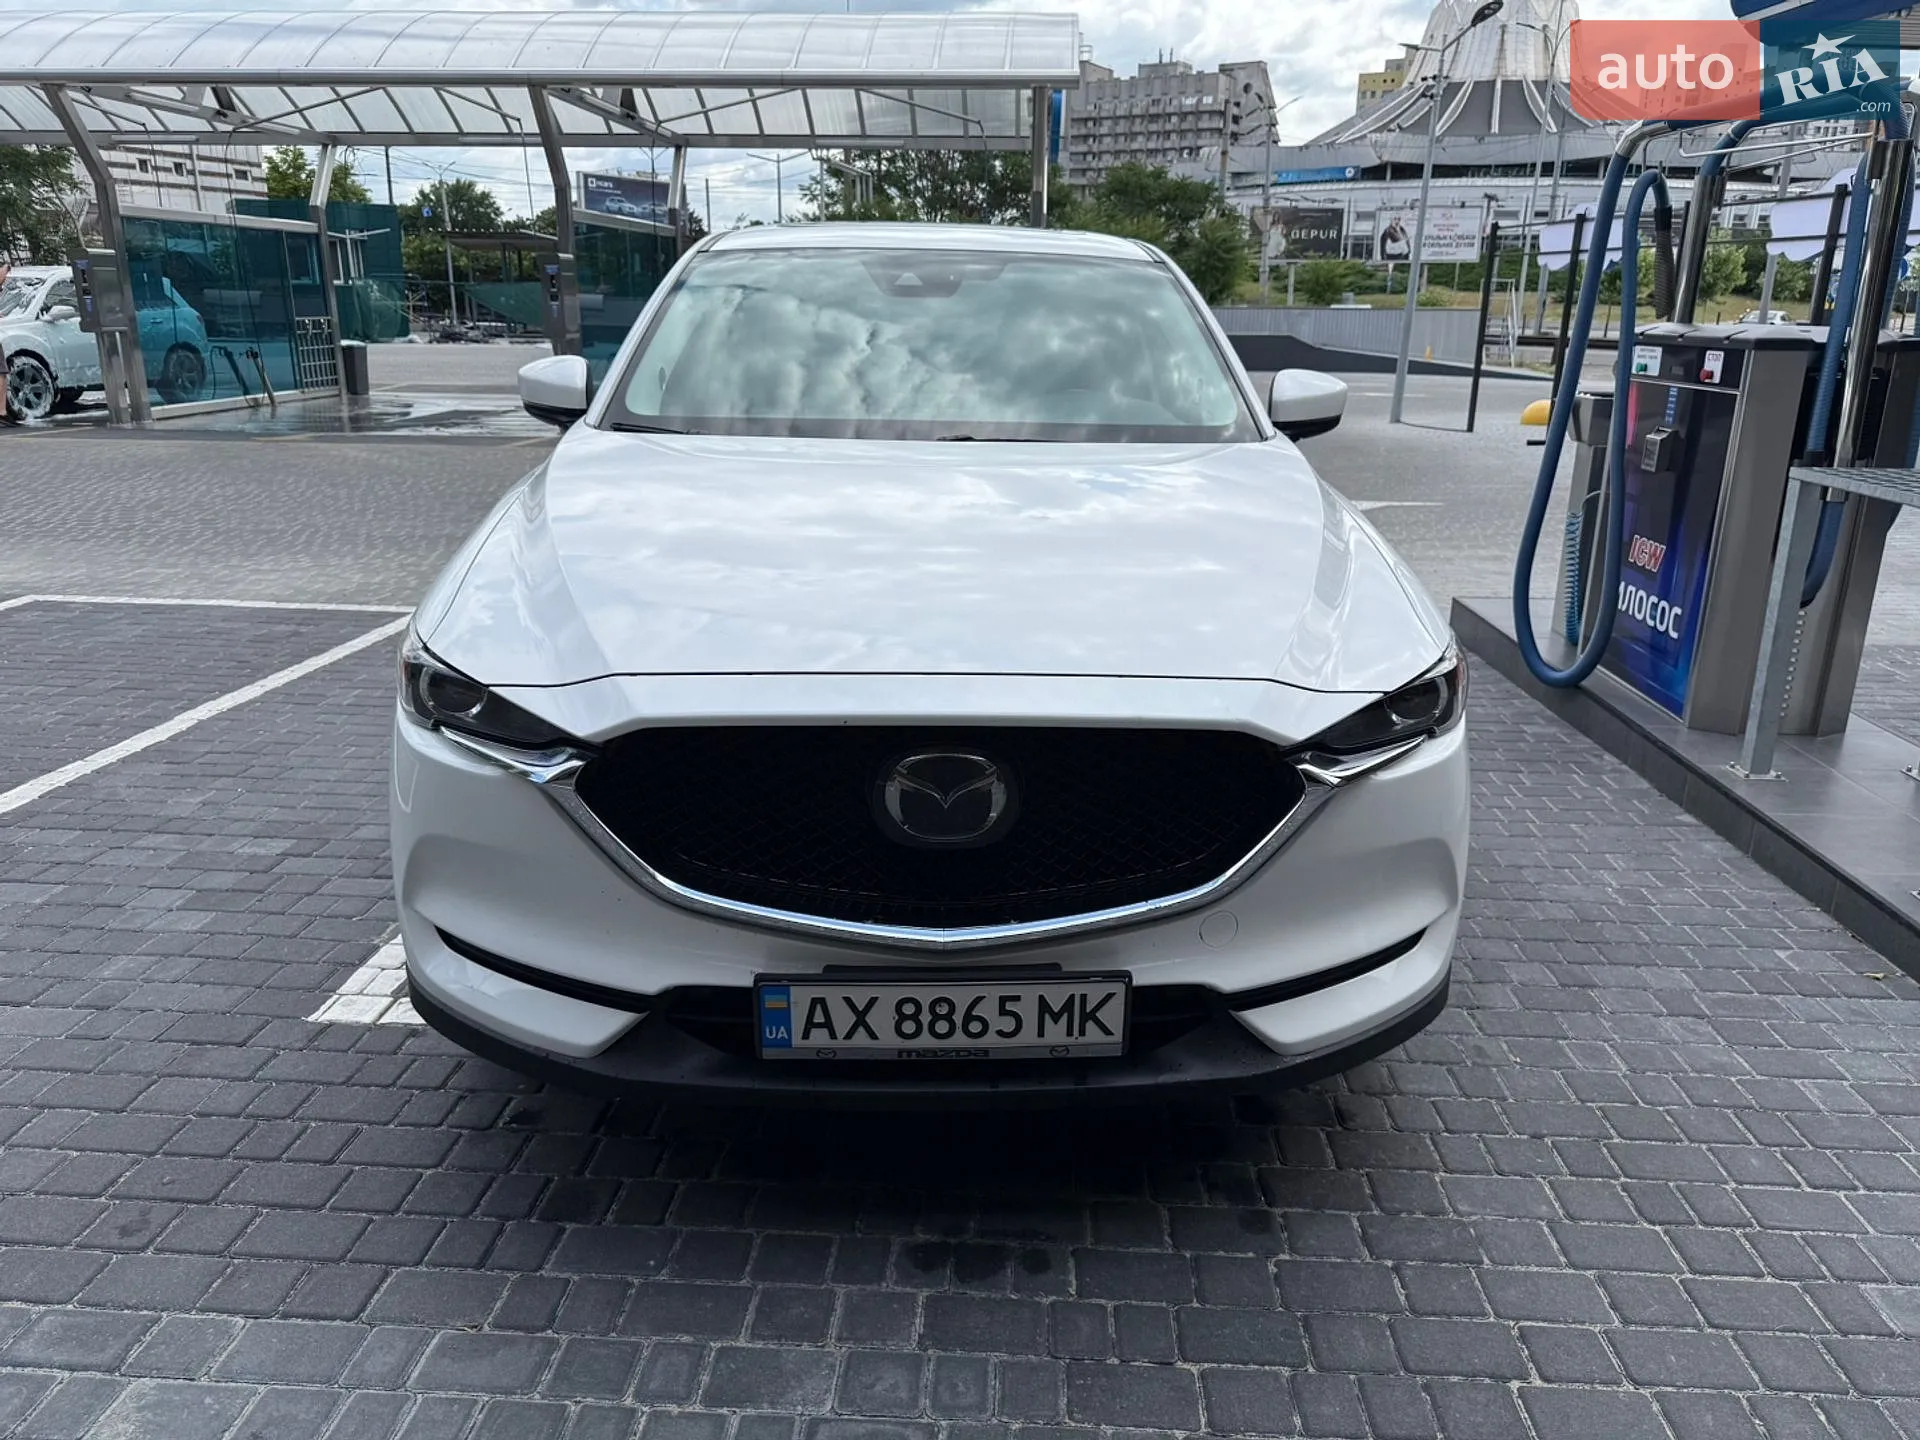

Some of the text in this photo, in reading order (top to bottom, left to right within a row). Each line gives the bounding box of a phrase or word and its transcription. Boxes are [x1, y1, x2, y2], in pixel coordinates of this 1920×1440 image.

[801, 992, 1117, 1040] AX 8865 MK
[765, 1026, 789, 1040] UA
